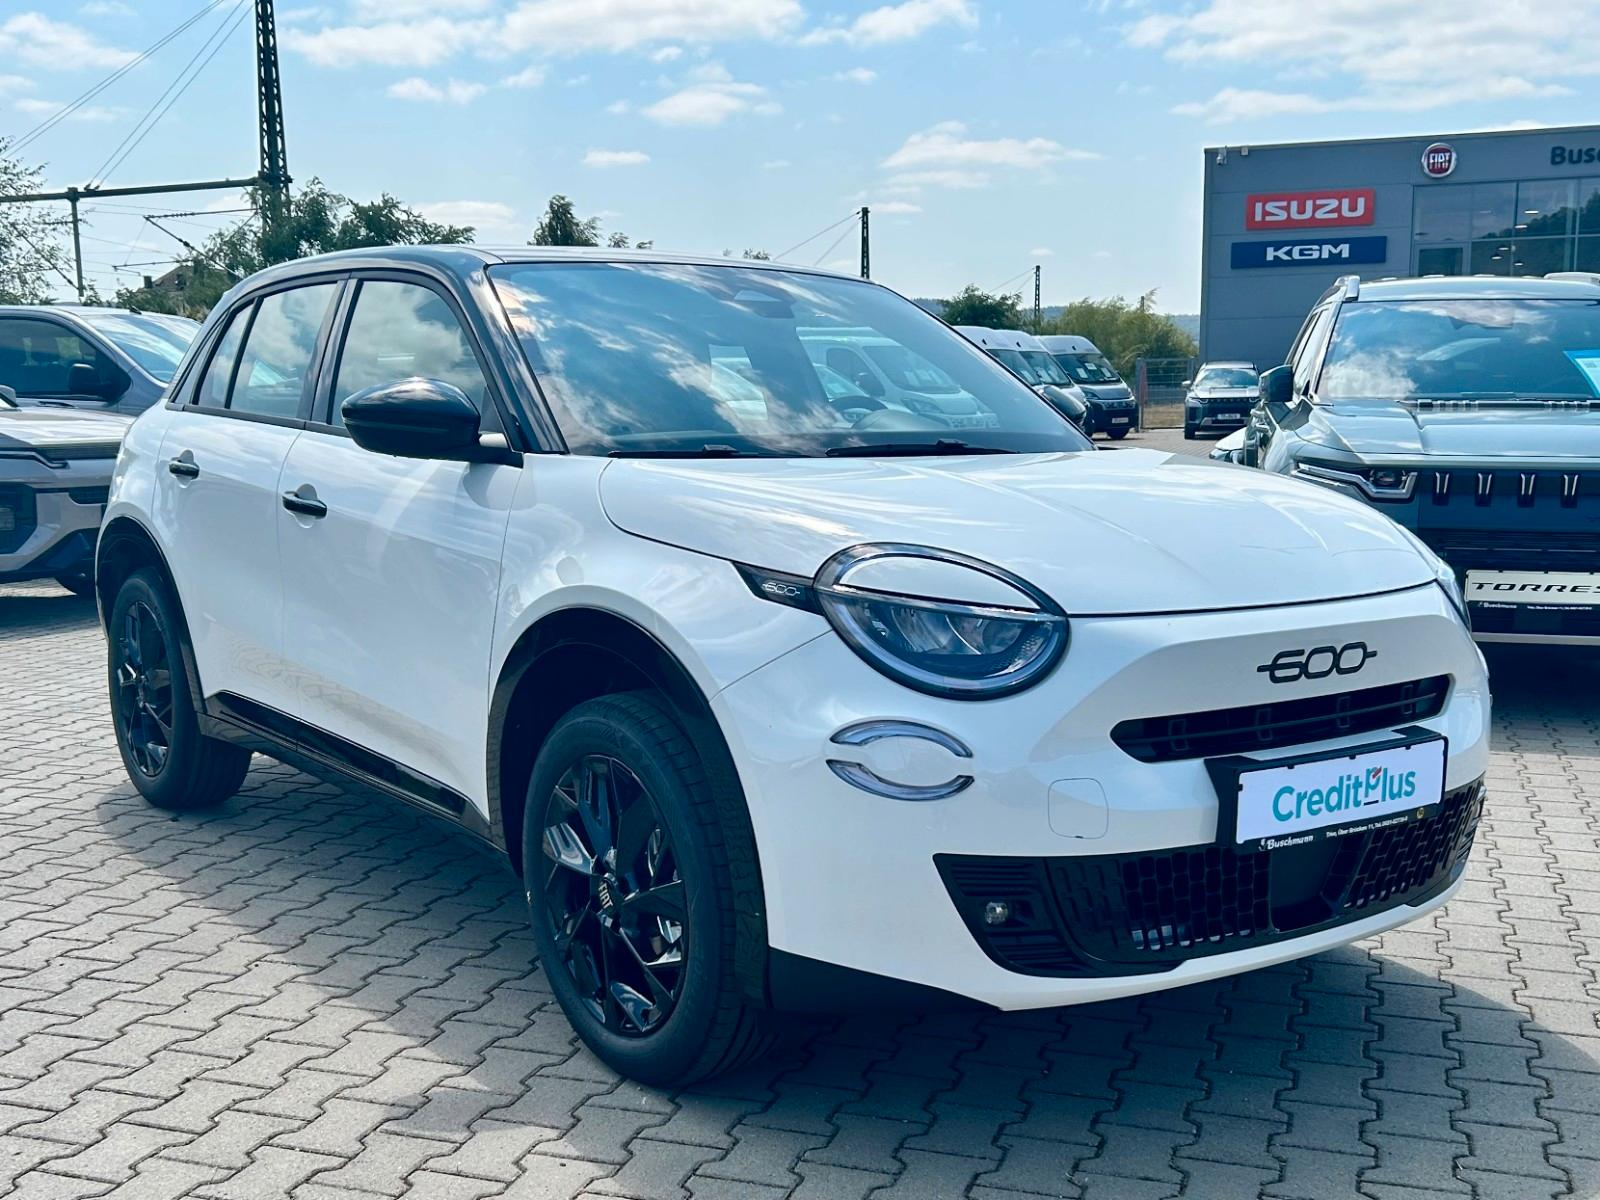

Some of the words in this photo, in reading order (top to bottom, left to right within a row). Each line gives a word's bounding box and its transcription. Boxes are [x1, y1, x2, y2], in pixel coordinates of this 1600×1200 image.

[1429, 152, 1450, 169] FIAT
[1551, 146, 1600, 165] Bus
[1254, 197, 1365, 221] ISUZU
[1266, 244, 1350, 261] KGM
[762, 582, 800, 596] 600
[1257, 641, 1377, 683] 600
[1266, 835, 1314, 850] Buschmann
[598, 883, 613, 909] FIAT
